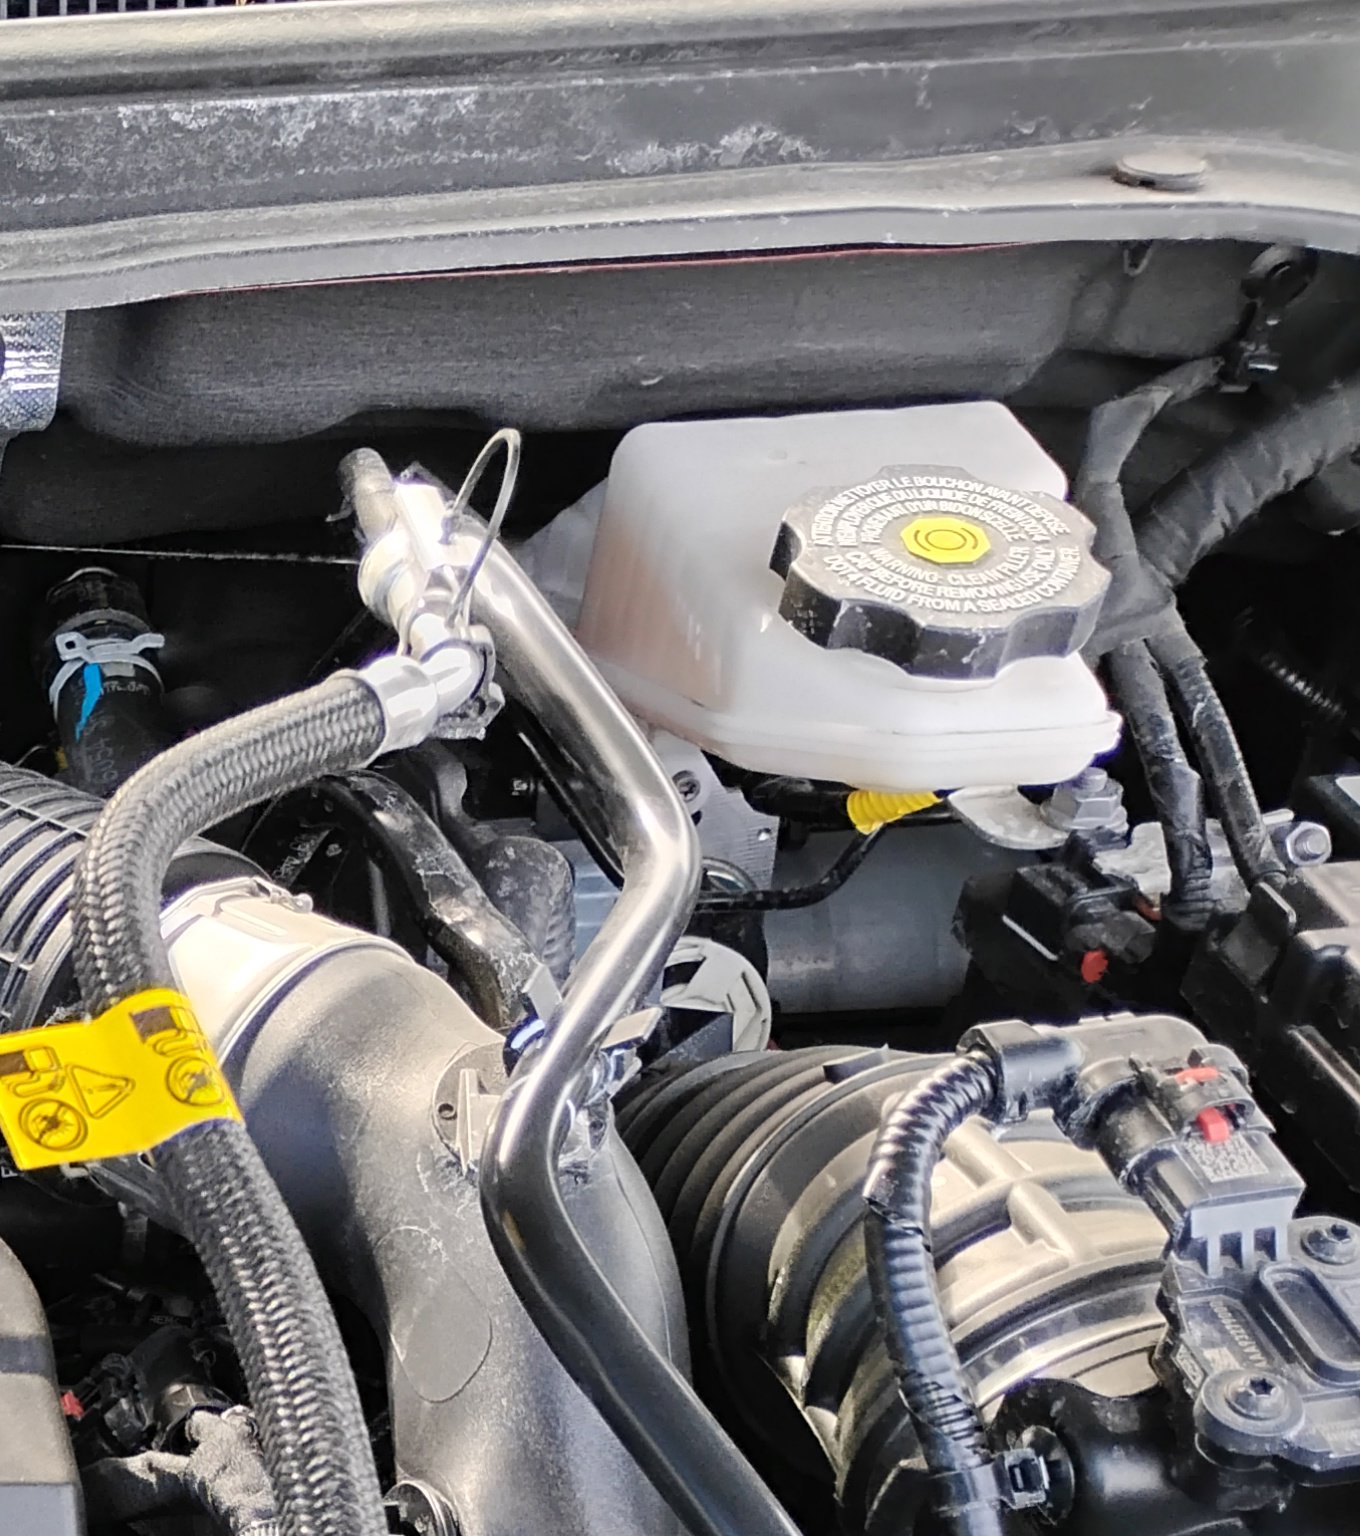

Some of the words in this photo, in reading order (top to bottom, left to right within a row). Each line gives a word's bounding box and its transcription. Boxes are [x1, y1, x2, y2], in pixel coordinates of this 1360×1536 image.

[888, 488, 915, 501] DU
[966, 492, 994, 507] DE
[890, 476, 914, 488] LE
[911, 475, 985, 493] BOUCHON
[979, 484, 1034, 508] AVANT
[1021, 502, 1072, 535] DEPOSE
[938, 499, 986, 518] BIDON
[844, 550, 882, 572] CAP
[947, 567, 1008, 585] CLEAN
[994, 545, 1030, 576] FILLER
[1028, 545, 1055, 572] ONLY
[866, 566, 937, 595] BEFORE
[935, 578, 1027, 597] REMOVING
[1012, 566, 1048, 586] USE
[853, 576, 908, 602] FLUID
[904, 592, 961, 610] FROM
[960, 600, 979, 612] A
[974, 588, 1044, 612] SEALED
